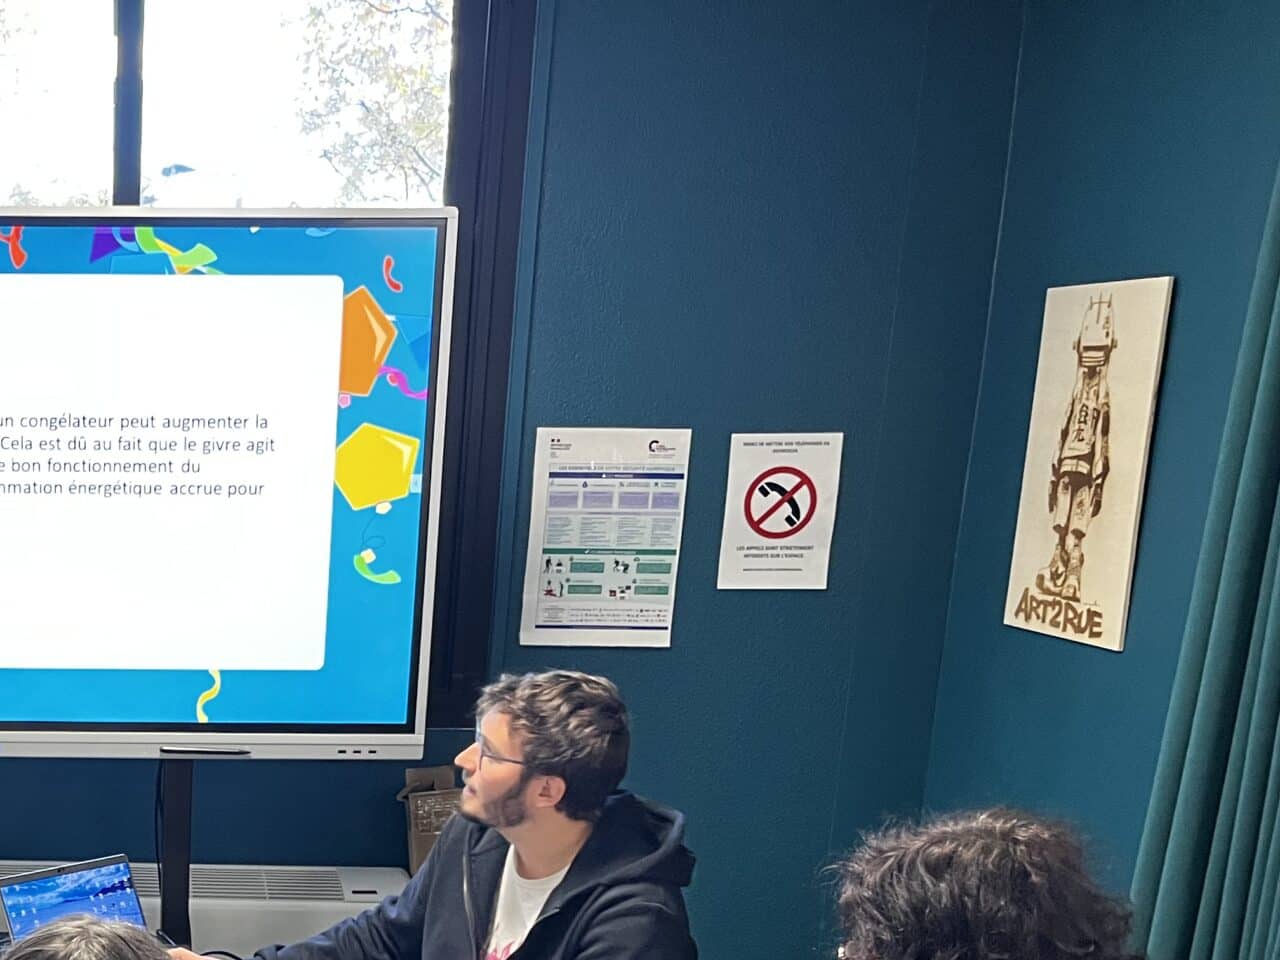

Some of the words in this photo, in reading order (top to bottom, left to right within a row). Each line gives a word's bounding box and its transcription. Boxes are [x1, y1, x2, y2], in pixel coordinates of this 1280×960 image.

[20, 413, 114, 431] congélateur
[121, 416, 155, 431] peut
[163, 416, 248, 432] augmenter
[256, 414, 267, 428] la
[1, 436, 32, 450] Cela
[39, 438, 61, 450] est
[68, 436, 86, 450] dû
[93, 440, 111, 450] au
[118, 436, 141, 451] fait
[149, 441, 177, 454] que
[184, 437, 196, 451] le
[203, 441, 240, 454] givre
[247, 439, 274, 454] agit
[12, 457, 40, 472] bon
[48, 458, 173, 472] fonctionnement
[181, 460, 200, 473] du
[69, 480, 162, 497] énergétique
[170, 485, 222, 495] accrue
[228, 485, 264, 498] pour
[1014, 587, 1102, 638] ART2RUE
